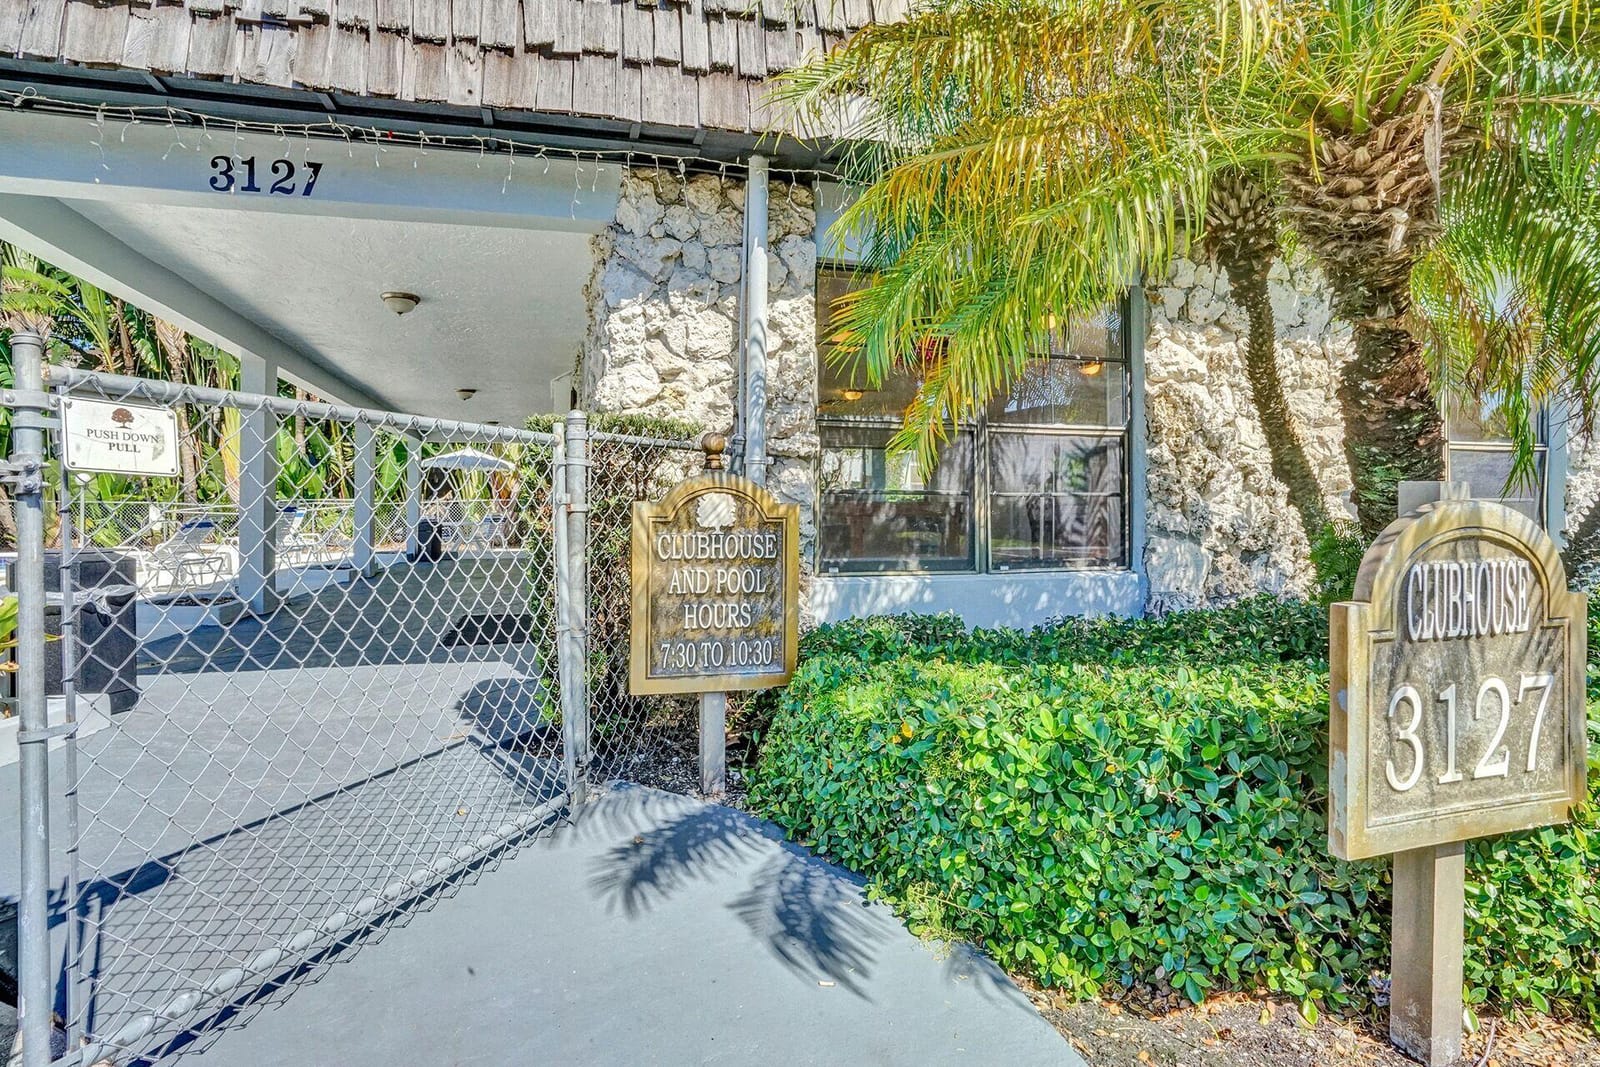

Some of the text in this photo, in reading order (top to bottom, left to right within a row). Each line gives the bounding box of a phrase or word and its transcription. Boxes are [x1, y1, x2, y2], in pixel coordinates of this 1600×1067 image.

[209, 155, 323, 196] 3127
[87, 428, 160, 443] PUSH DOWN
[109, 442, 141, 453] PULL
[657, 534, 777, 560] CLUBHOUSE
[668, 569, 767, 594] AND POOL
[1407, 560, 1530, 642] CLUBHOUSE
[683, 604, 751, 629] HOURS
[661, 640, 773, 669] 7:30 TO 10:30
[1385, 674, 1554, 793] 3127
